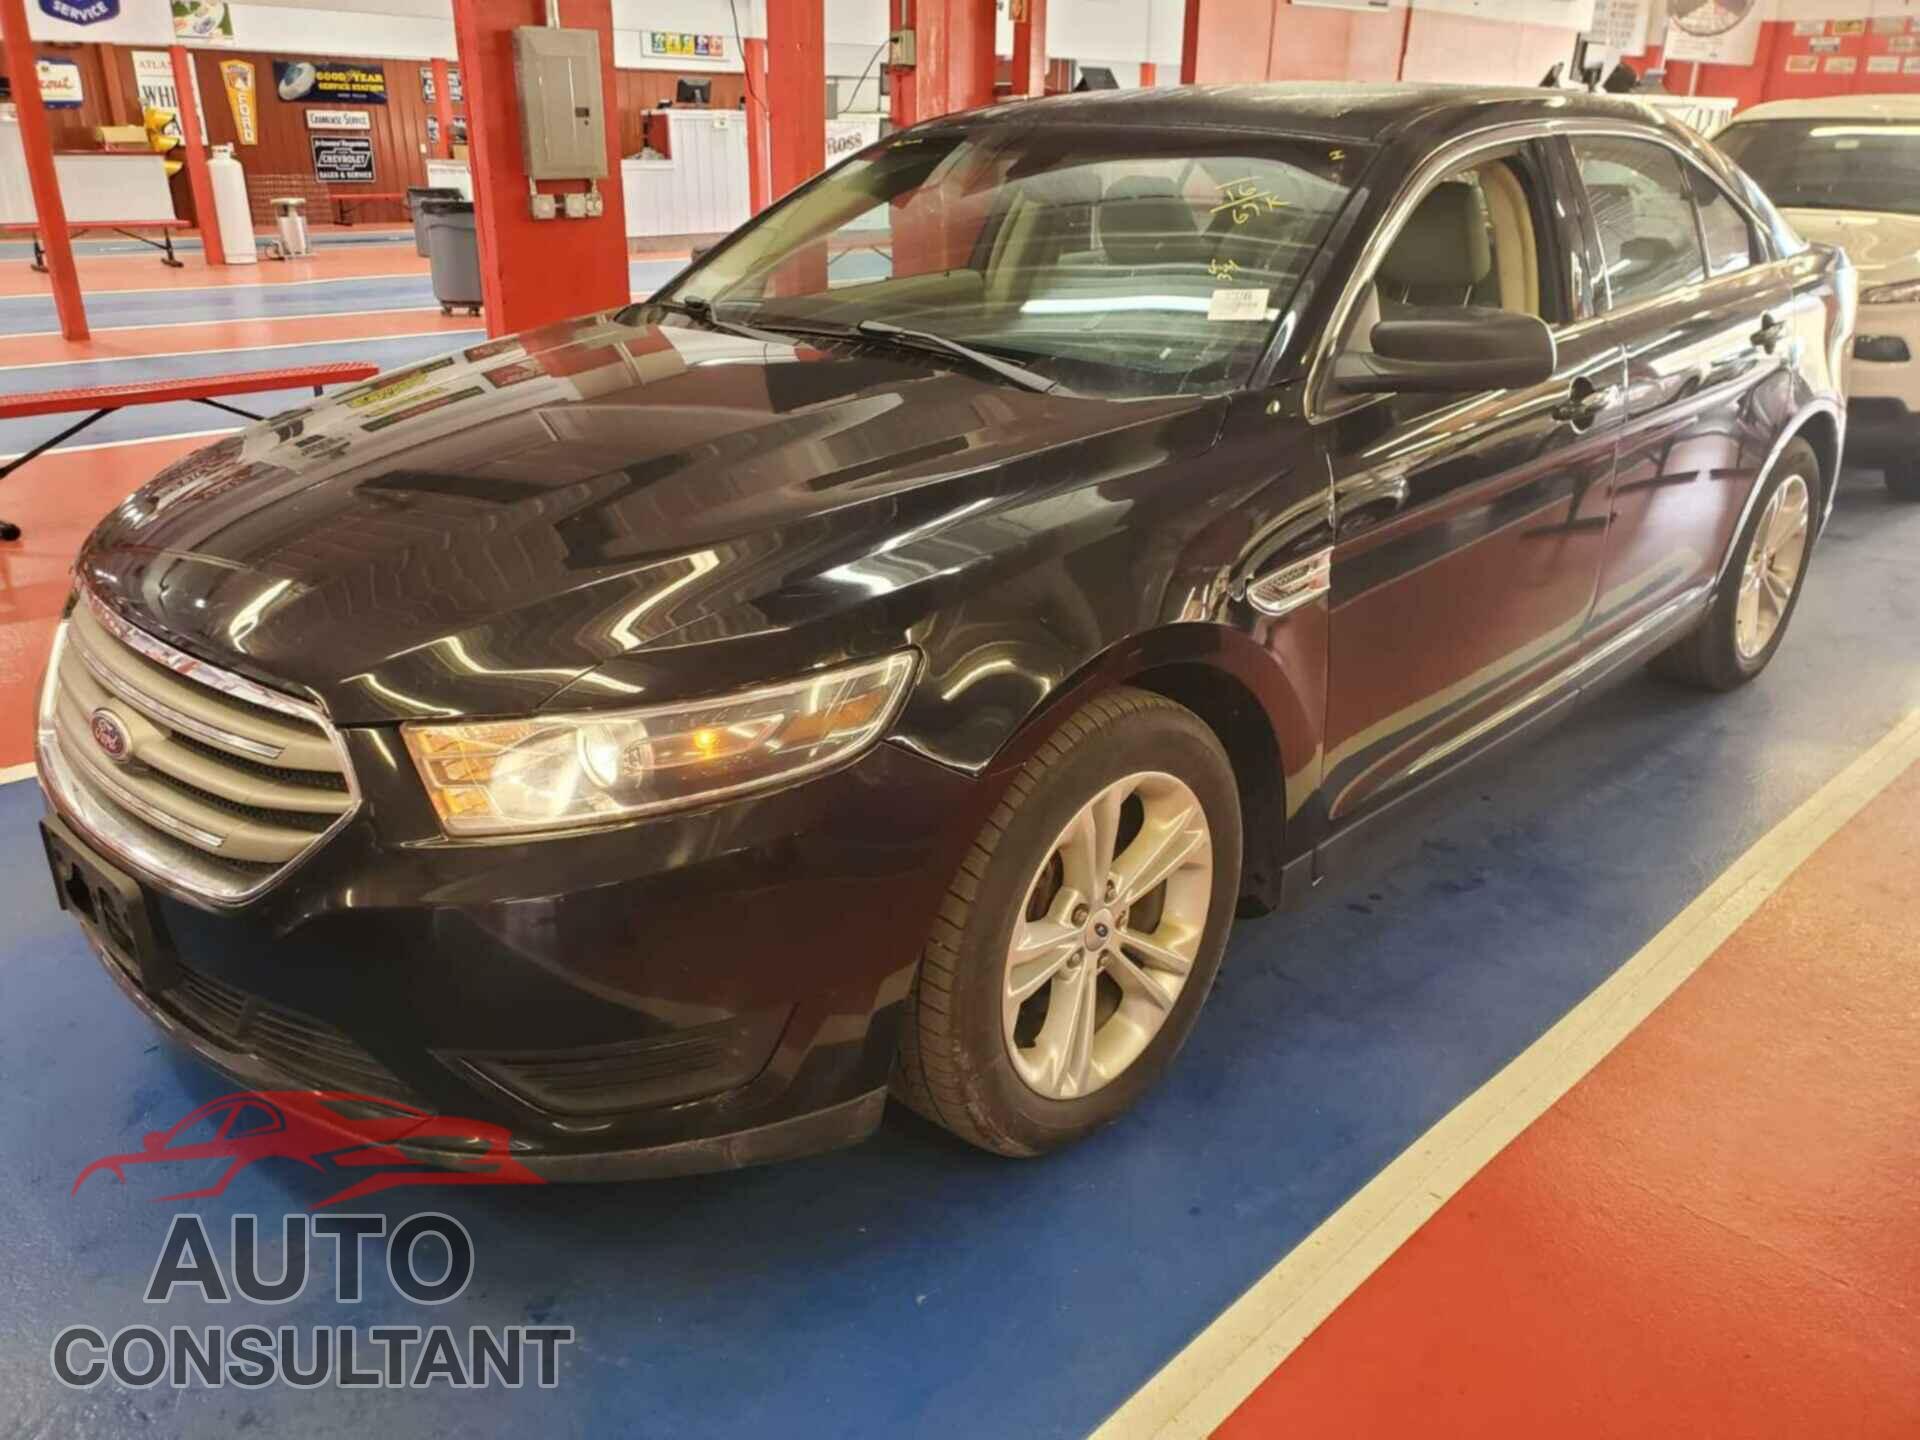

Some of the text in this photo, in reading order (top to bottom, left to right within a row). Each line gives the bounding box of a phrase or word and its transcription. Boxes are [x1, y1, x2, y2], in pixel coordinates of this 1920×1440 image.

[52, 0, 109, 20] SERVICE
[139, 60, 173, 70] ATLA
[142, 85, 177, 107] WHI
[322, 153, 365, 164] CHEVROLET
